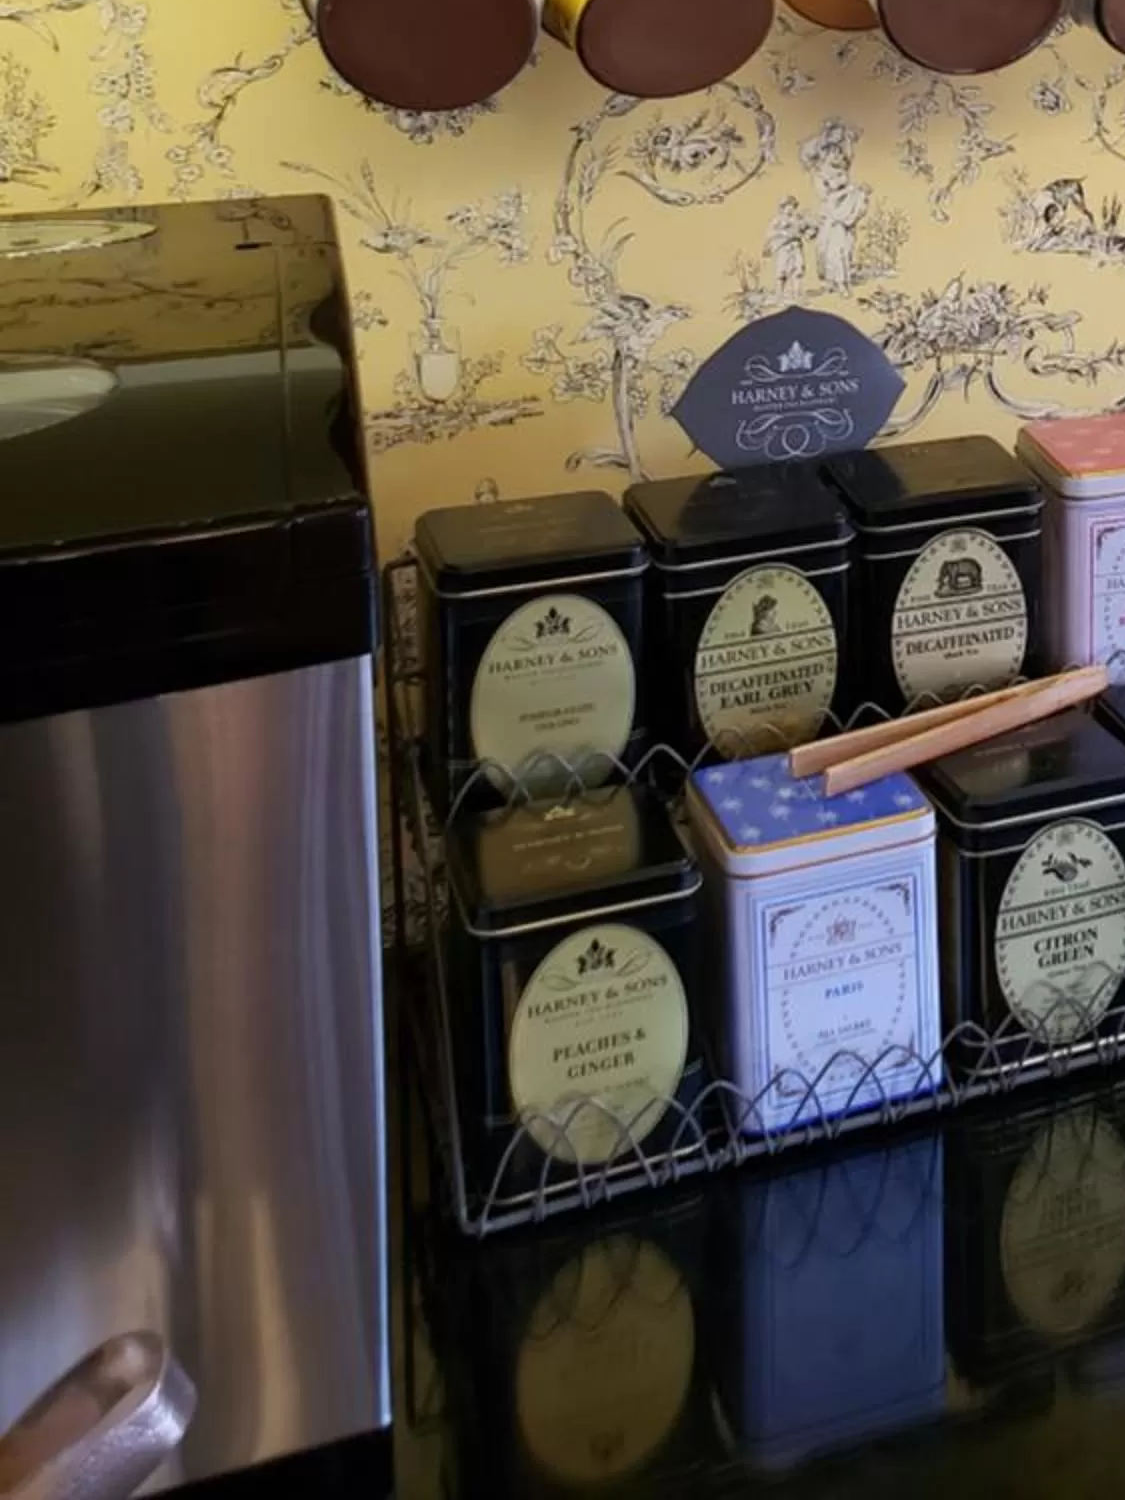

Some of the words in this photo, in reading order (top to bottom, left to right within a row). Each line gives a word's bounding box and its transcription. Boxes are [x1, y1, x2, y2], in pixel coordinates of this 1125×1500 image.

[731, 384, 799, 405] HARNEY
[801, 385, 816, 398] &
[818, 377, 861, 397] SONS
[896, 607, 964, 629] HARNEY
[965, 606, 979, 618] &
[983, 600, 1021, 616] SONS
[701, 644, 772, 669] HARNEY
[773, 644, 785, 656] &
[790, 635, 832, 650] SONS
[906, 626, 1015, 656] DECAFFEINATED
[488, 654, 555, 674] HARNEY
[559, 651, 574, 663] &
[578, 642, 619, 659] SONS
[709, 662, 824, 696] DECAFFEINATED
[720, 689, 765, 710] EARL
[768, 679, 815, 700] GREY
[1001, 903, 1070, 931] HARNEY
[1072, 902, 1086, 916] &
[1034, 926, 1098, 954] CITRON
[783, 954, 846, 981] HARNEY
[848, 952, 861, 965] &
[864, 942, 903, 961] SONS
[1038, 944, 1095, 969] GREEN
[527, 991, 600, 1019] HARNEY
[605, 987, 620, 999] &
[623, 974, 668, 992] SONS
[824, 980, 864, 1000] PARIS
[552, 1031, 631, 1063] PEACHES
[633, 1027, 647, 1041] &
[566, 1051, 635, 1079] GINGER
